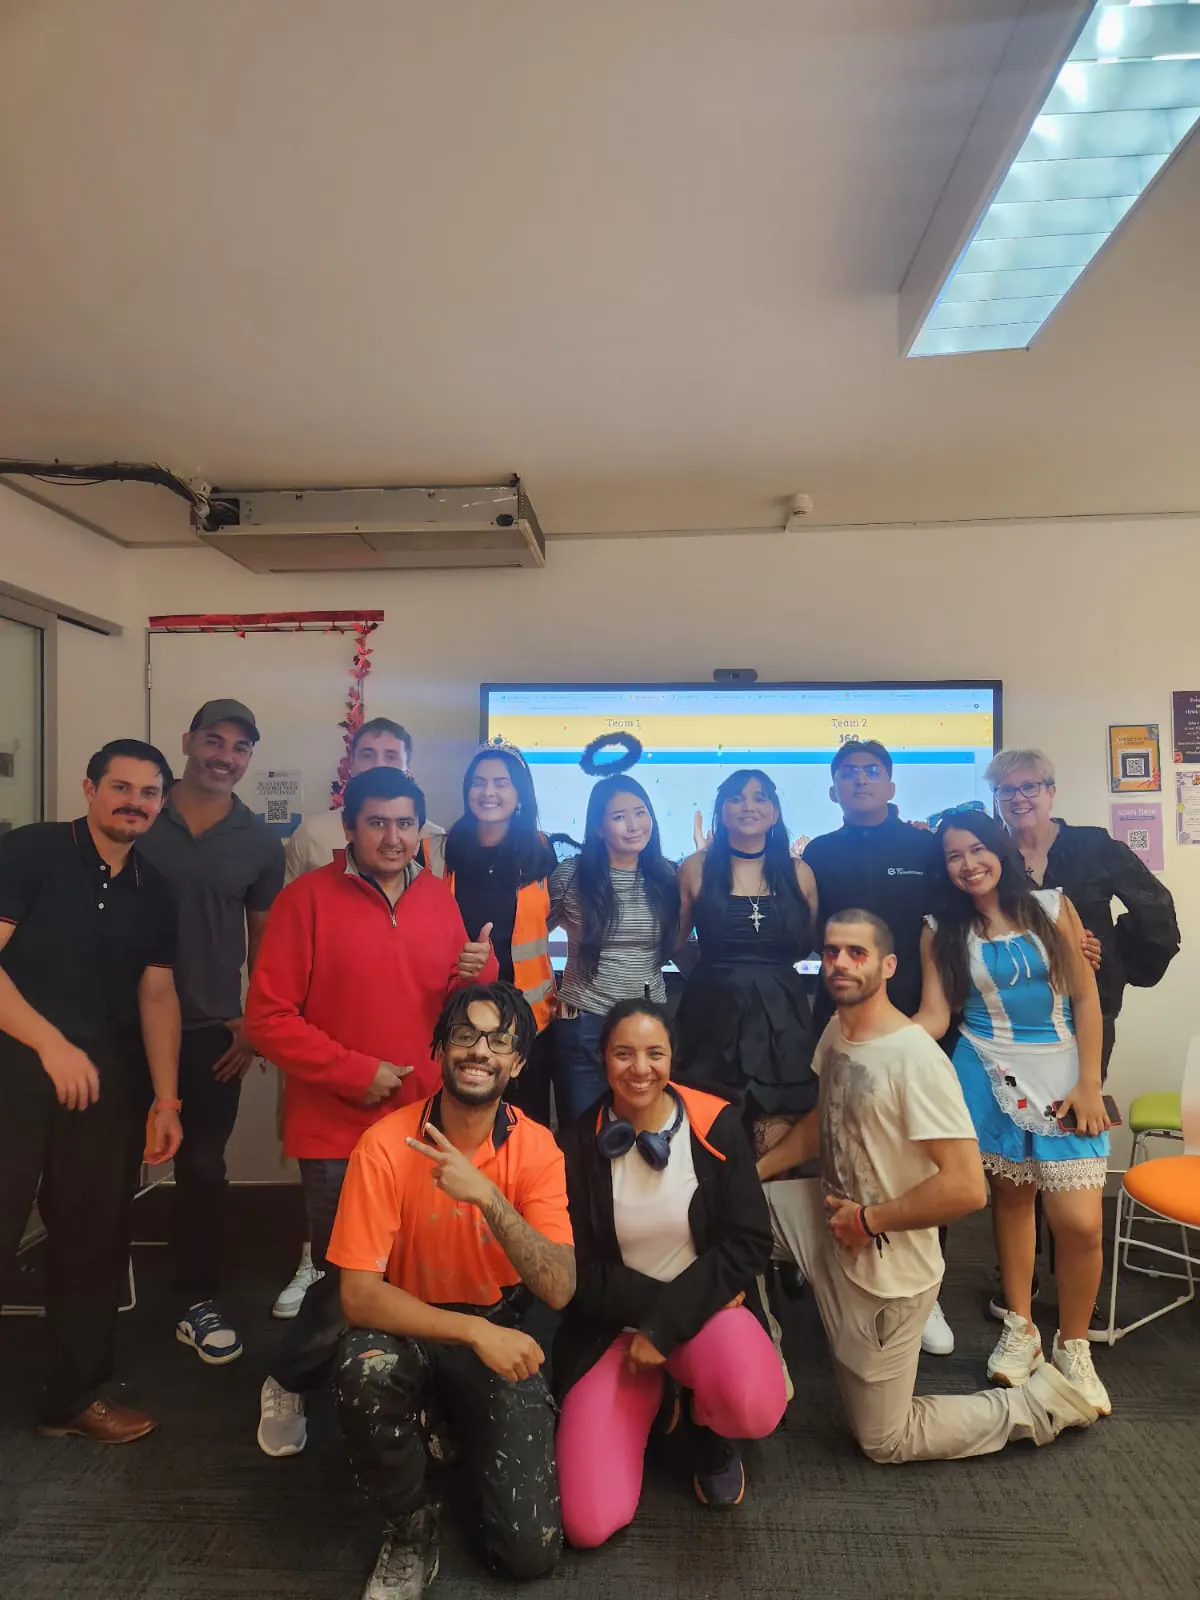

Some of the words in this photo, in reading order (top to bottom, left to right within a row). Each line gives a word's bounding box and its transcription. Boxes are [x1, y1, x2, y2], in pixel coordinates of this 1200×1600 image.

[606, 719, 633, 727] Team
[832, 719, 859, 727] Team
[861, 719, 868, 727] 2
